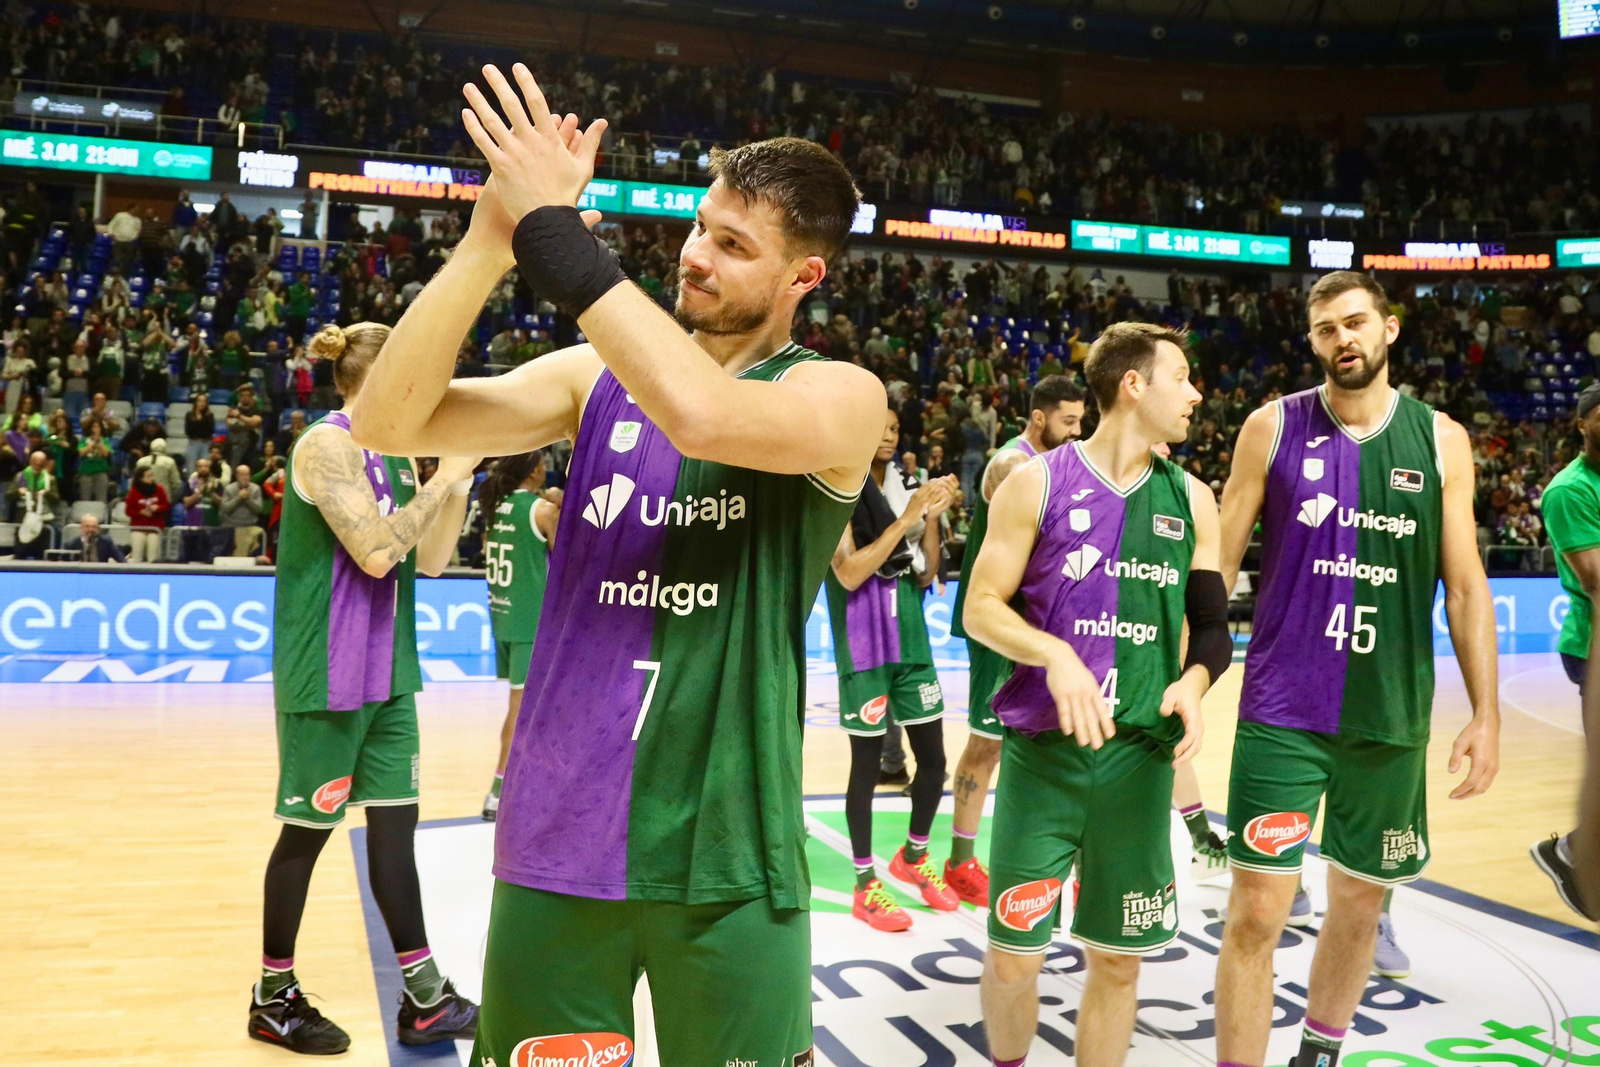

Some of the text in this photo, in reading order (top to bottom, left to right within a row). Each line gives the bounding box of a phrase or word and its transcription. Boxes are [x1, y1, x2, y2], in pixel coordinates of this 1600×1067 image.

[41, 142, 78, 162] 3.04
[309, 172, 486, 201] PROMITHEAS PAT
[364, 161, 453, 183] UNICAJA
[664, 192, 694, 211] 3.04
[885, 219, 998, 244] PROMITHEAS
[1000, 229, 1066, 249] PATRAS
[1363, 254, 1550, 270] PROMITHEAS PATRAS
[640, 489, 746, 530] Unicaja
[1338, 507, 1417, 539] Unicaja
[486, 541, 514, 587] 55
[1104, 557, 1179, 588] Unicaja
[1, 583, 270, 651] endes
[1074, 611, 1158, 645] málaga
[1324, 603, 1378, 654] 45
[631, 660, 661, 740] 7
[1100, 668, 1120, 718] 4
[1382, 844, 1417, 862] laga
[1130, 889, 1164, 913] má
[1123, 909, 1163, 930] laga
